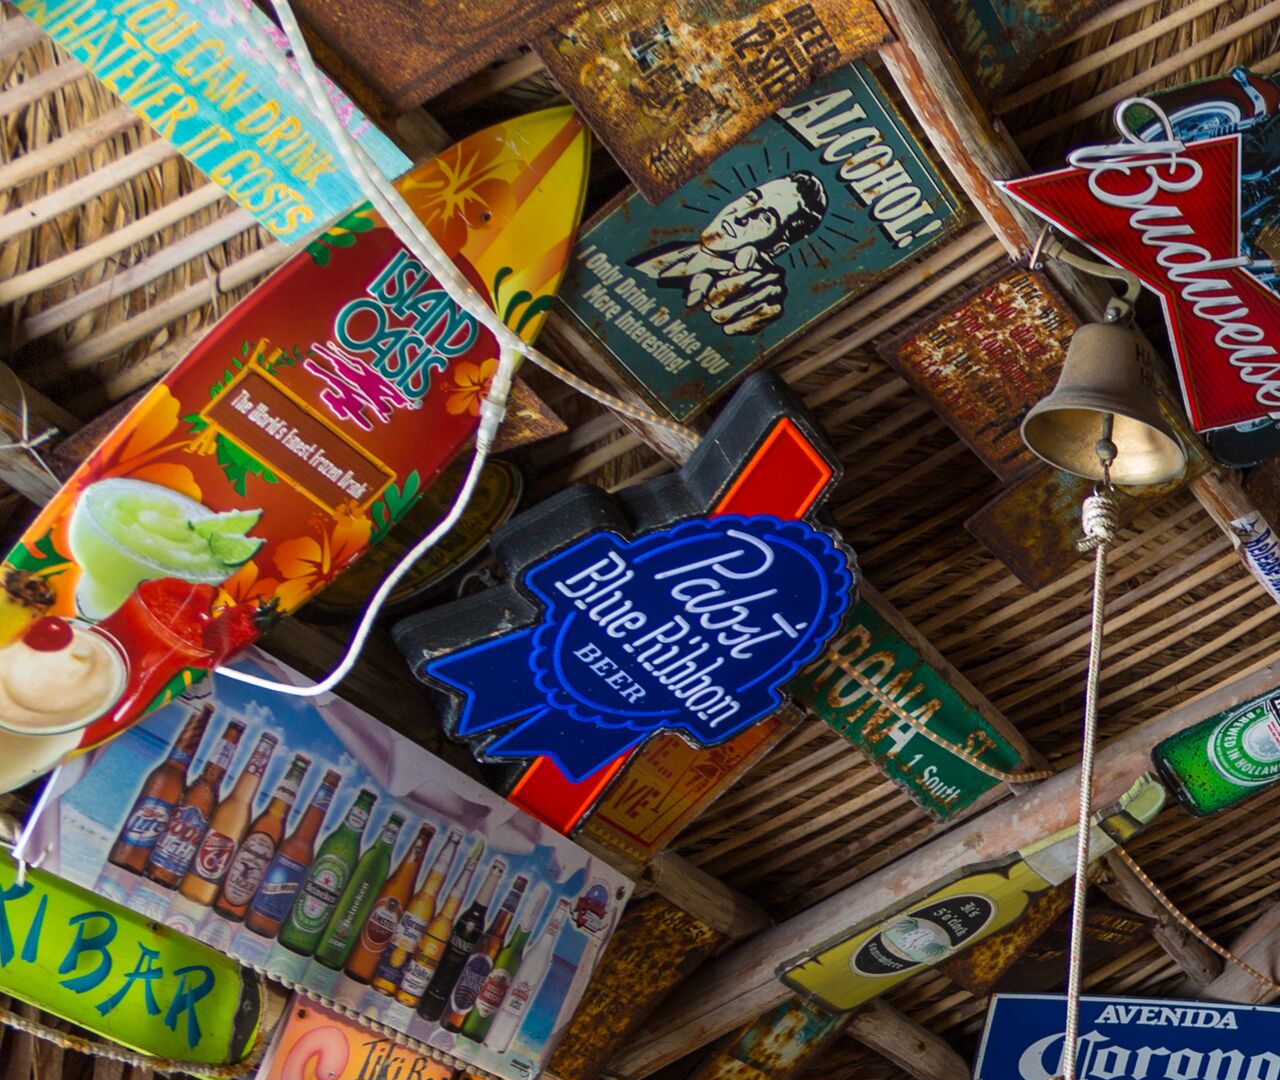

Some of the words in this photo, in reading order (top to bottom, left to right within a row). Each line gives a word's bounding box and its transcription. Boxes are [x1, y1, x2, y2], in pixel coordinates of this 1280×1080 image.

[173, 38, 258, 114] CAN
[235, 100, 342, 189] DRINK
[776, 88, 944, 250] ALCOHOL!
[180, 122, 234, 161] IT
[209, 149, 314, 236] COSTS
[333, 297, 450, 400] OASIS
[367, 250, 481, 360] ISLAND
[583, 284, 621, 321] More
[614, 310, 690, 374] Interesting!
[585, 252, 623, 286] Only
[614, 277, 656, 316] Drink
[663, 319, 700, 354] Make
[695, 346, 729, 374] YOU
[230, 389, 254, 414] The
[248, 403, 288, 440] World's
[281, 428, 317, 460] Finest
[308, 449, 342, 482] Frozen
[337, 470, 367, 499] Drink
[556, 549, 646, 640] Blue
[624, 615, 742, 727] Ribbon
[656, 530, 807, 659] Pabst
[572, 642, 647, 704] BEER
[921, 765, 961, 803] South
[58, 911, 215, 1049] BAR
[1094, 1005, 1239, 1031] AVENIDA
